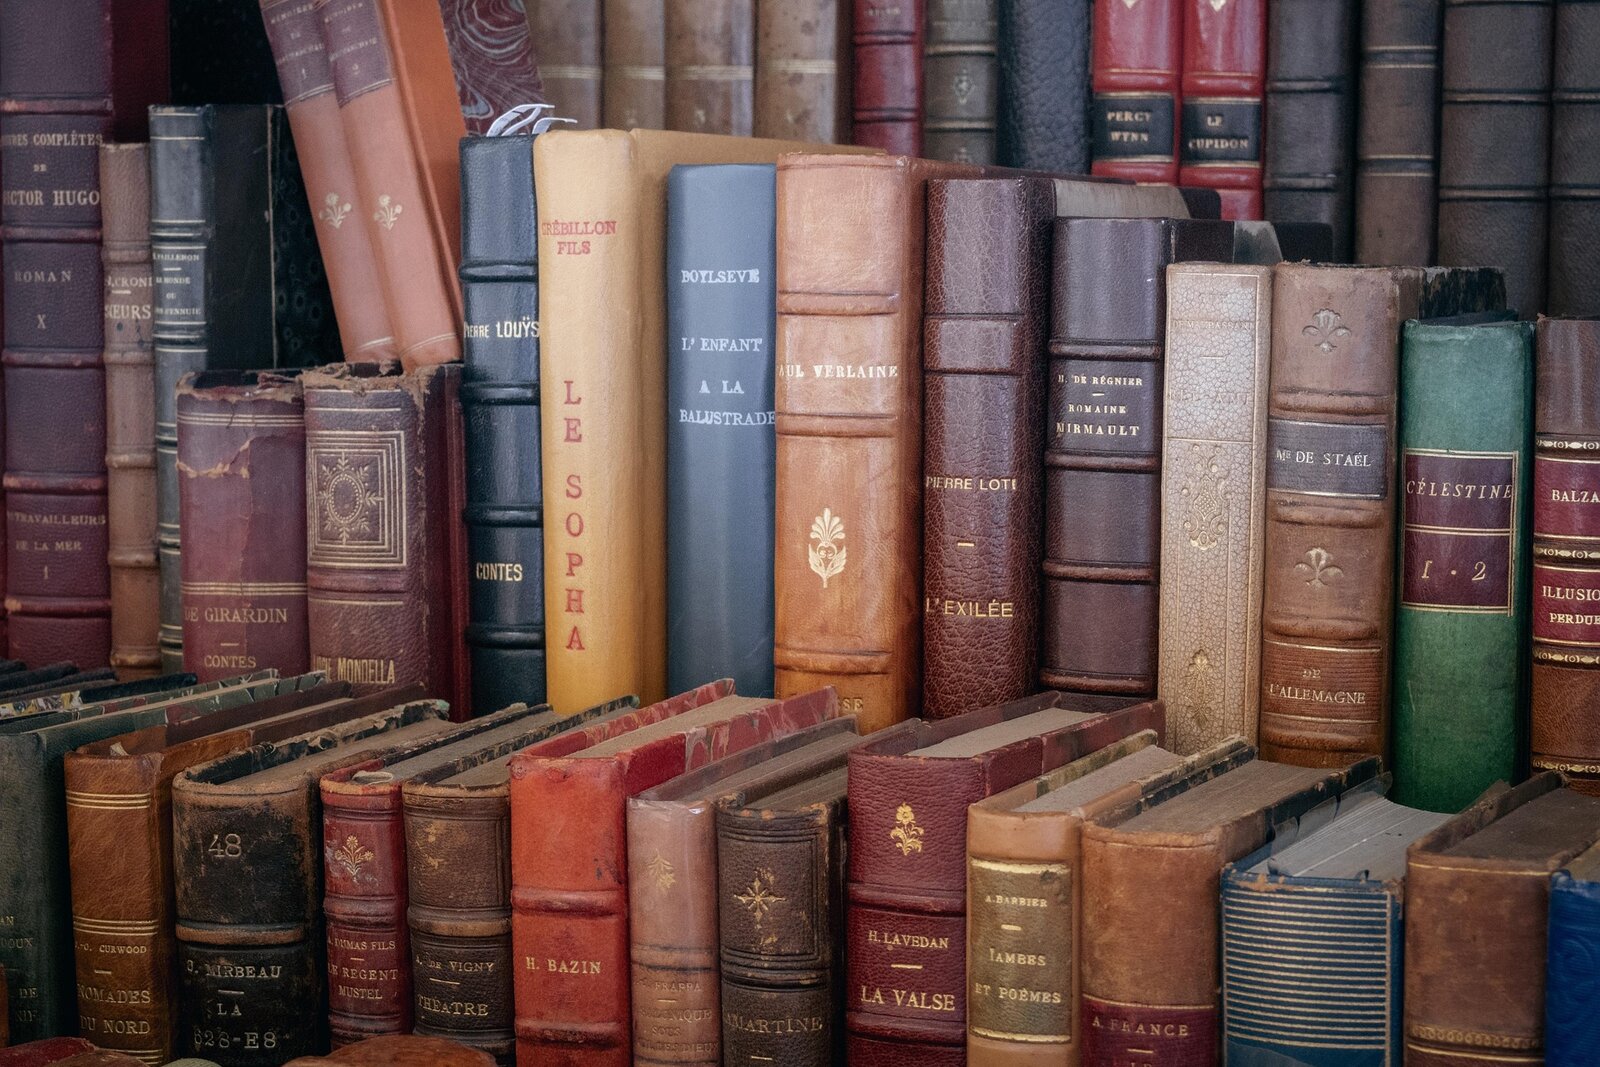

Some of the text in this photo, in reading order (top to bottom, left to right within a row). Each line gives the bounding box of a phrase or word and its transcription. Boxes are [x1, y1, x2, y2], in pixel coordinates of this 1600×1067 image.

[1107, 112, 1152, 122] PERCY
[1206, 116, 1224, 127] LE
[1110, 132, 1149, 142] WYNN
[1188, 139, 1249, 149] CUPIDON
[53, 190, 100, 206] HUGO
[557, 241, 591, 255] FILS
[14, 269, 72, 285] ROMAN
[37, 314, 46, 329] X
[813, 364, 898, 379] VERLAINE
[699, 380, 744, 394] A LA
[1092, 375, 1143, 386] RÉGNIER
[1068, 403, 1128, 414] ROMAINE
[679, 408, 776, 426] BALUSTRADE
[1295, 450, 1315, 464] DE
[1322, 452, 1373, 467] STAËL
[925, 476, 1017, 491] PIERRE LOTI
[1406, 477, 1514, 499] CÉLESTINE
[564, 381, 586, 651] LE SOPHA
[34, 541, 49, 551] LA
[55, 541, 82, 551] MER
[475, 562, 524, 582] CONTES
[204, 607, 289, 624] GIRARDIN
[203, 655, 257, 669] CONTES
[337, 657, 396, 685] MONDELLA
[1269, 683, 1367, 704] L'ALLEMAGNE
[208, 833, 242, 858] 48
[371, 940, 397, 951] FILS
[884, 932, 949, 949] LAVEDAN
[99, 944, 148, 954] CURWOOD
[205, 963, 283, 979] MIRBEAU
[449, 960, 496, 973] VIGNY
[525, 957, 602, 975] H. BAZIN
[78, 983, 152, 1005] NOMADES
[338, 984, 384, 1000] MUSTEL
[861, 985, 956, 1012] LA VALSE
[975, 982, 1062, 1005] ET POÈMES
[216, 1002, 243, 1016] LA
[80, 1015, 151, 1036] DU NORD
[1108, 1018, 1189, 1037] FRANCE
